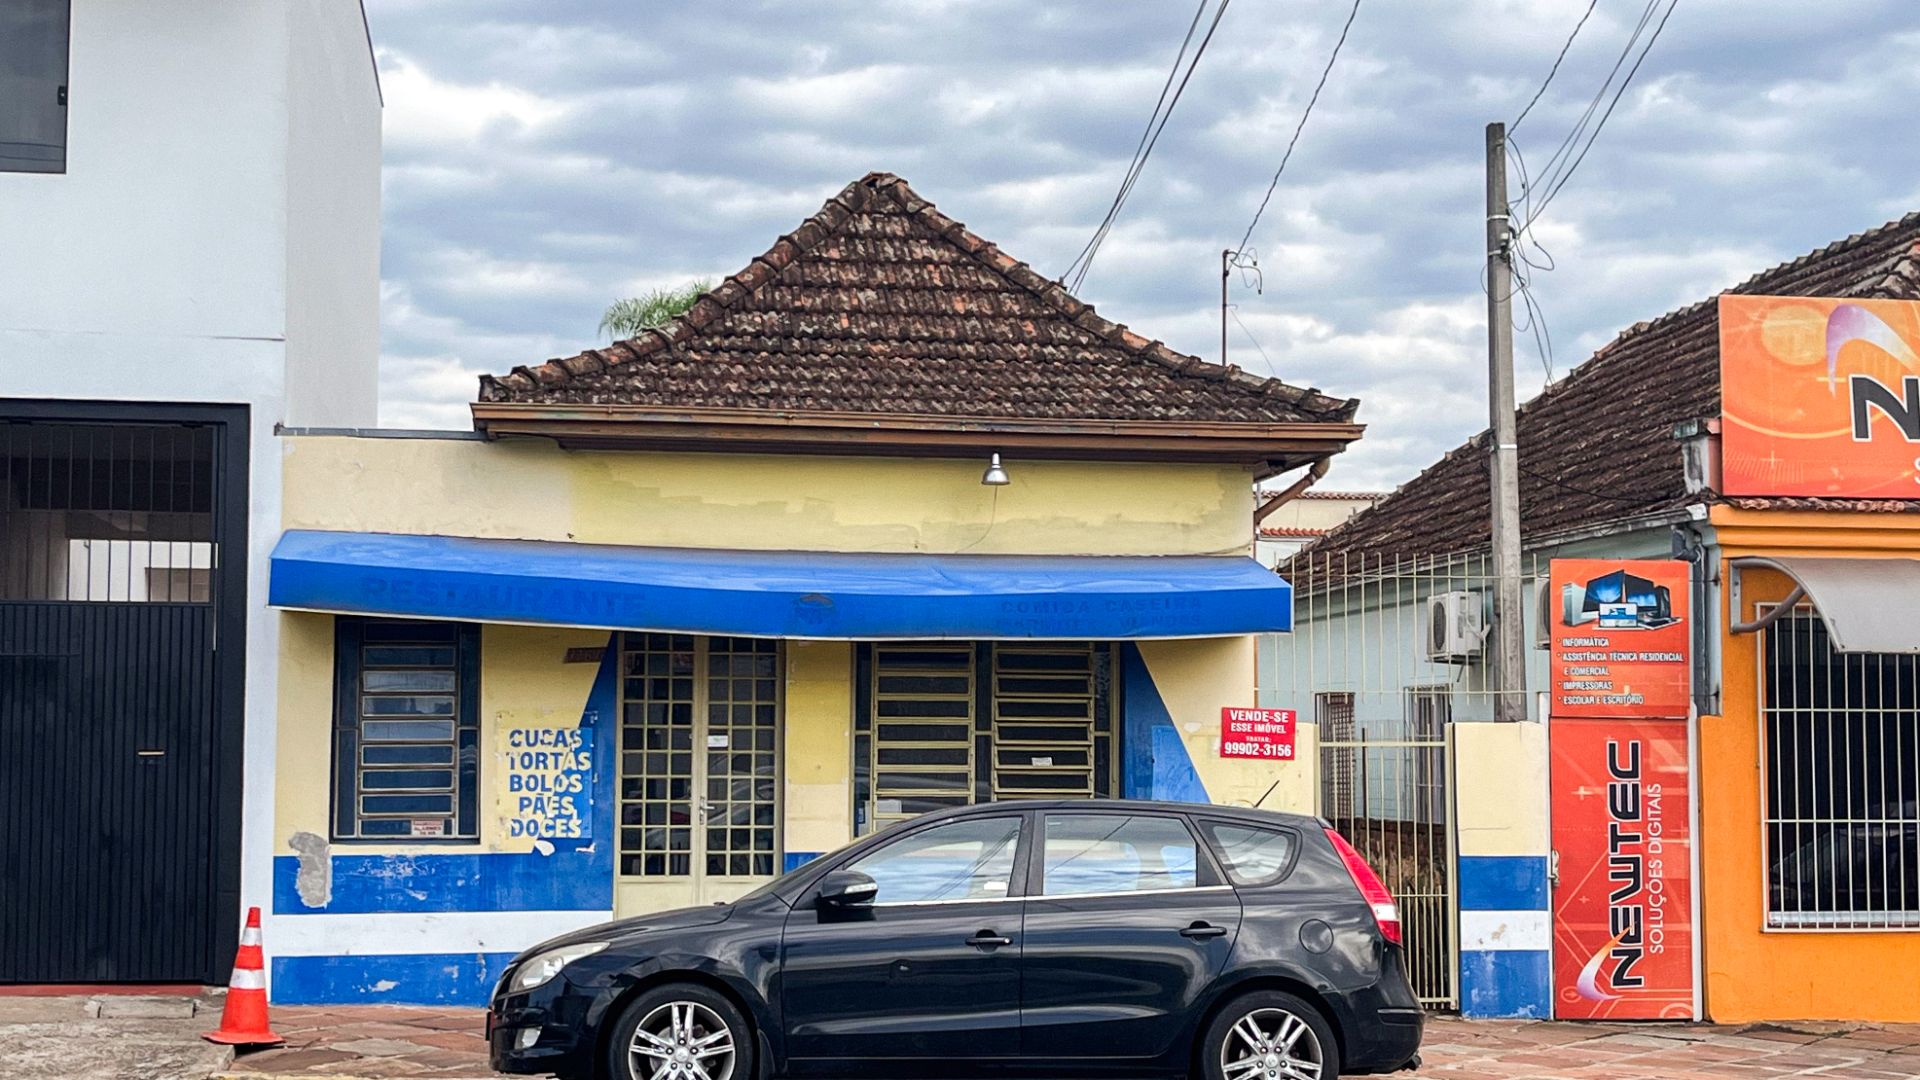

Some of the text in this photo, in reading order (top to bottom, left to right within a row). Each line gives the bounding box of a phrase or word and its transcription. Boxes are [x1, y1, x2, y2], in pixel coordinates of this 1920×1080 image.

[360, 577, 646, 618] RESTAURANTE
[1000, 596, 1202, 614] COMIDA CASEIRA
[1562, 636, 1609, 647] INFORMÁTICA
[1562, 651, 1607, 661] ASSISTÊNCIA
[1640, 652, 1684, 662] RESIDENCIAL
[1564, 666, 1609, 675] E COMERCIAL
[1563, 681, 1613, 690] IMPRESSORAS
[1563, 695, 1595, 704] ESCOLAR
[1603, 694, 1644, 704] ESCRITÓRIO
[1230, 710, 1289, 723] VENDE-SE
[1230, 722, 1287, 734] ESSE IMÓVEL
[509, 729, 583, 748] CUCAS
[1224, 741, 1292, 757] 99902-3156
[506, 751, 591, 771] TORTAS
[509, 774, 583, 793] BOLOS
[519, 793, 575, 816] PÃES
[510, 819, 582, 838] DOCES
[1606, 740, 1645, 989] NEWTEC
[1645, 783, 1667, 955] SOLUÇÕES DIGITAIS
